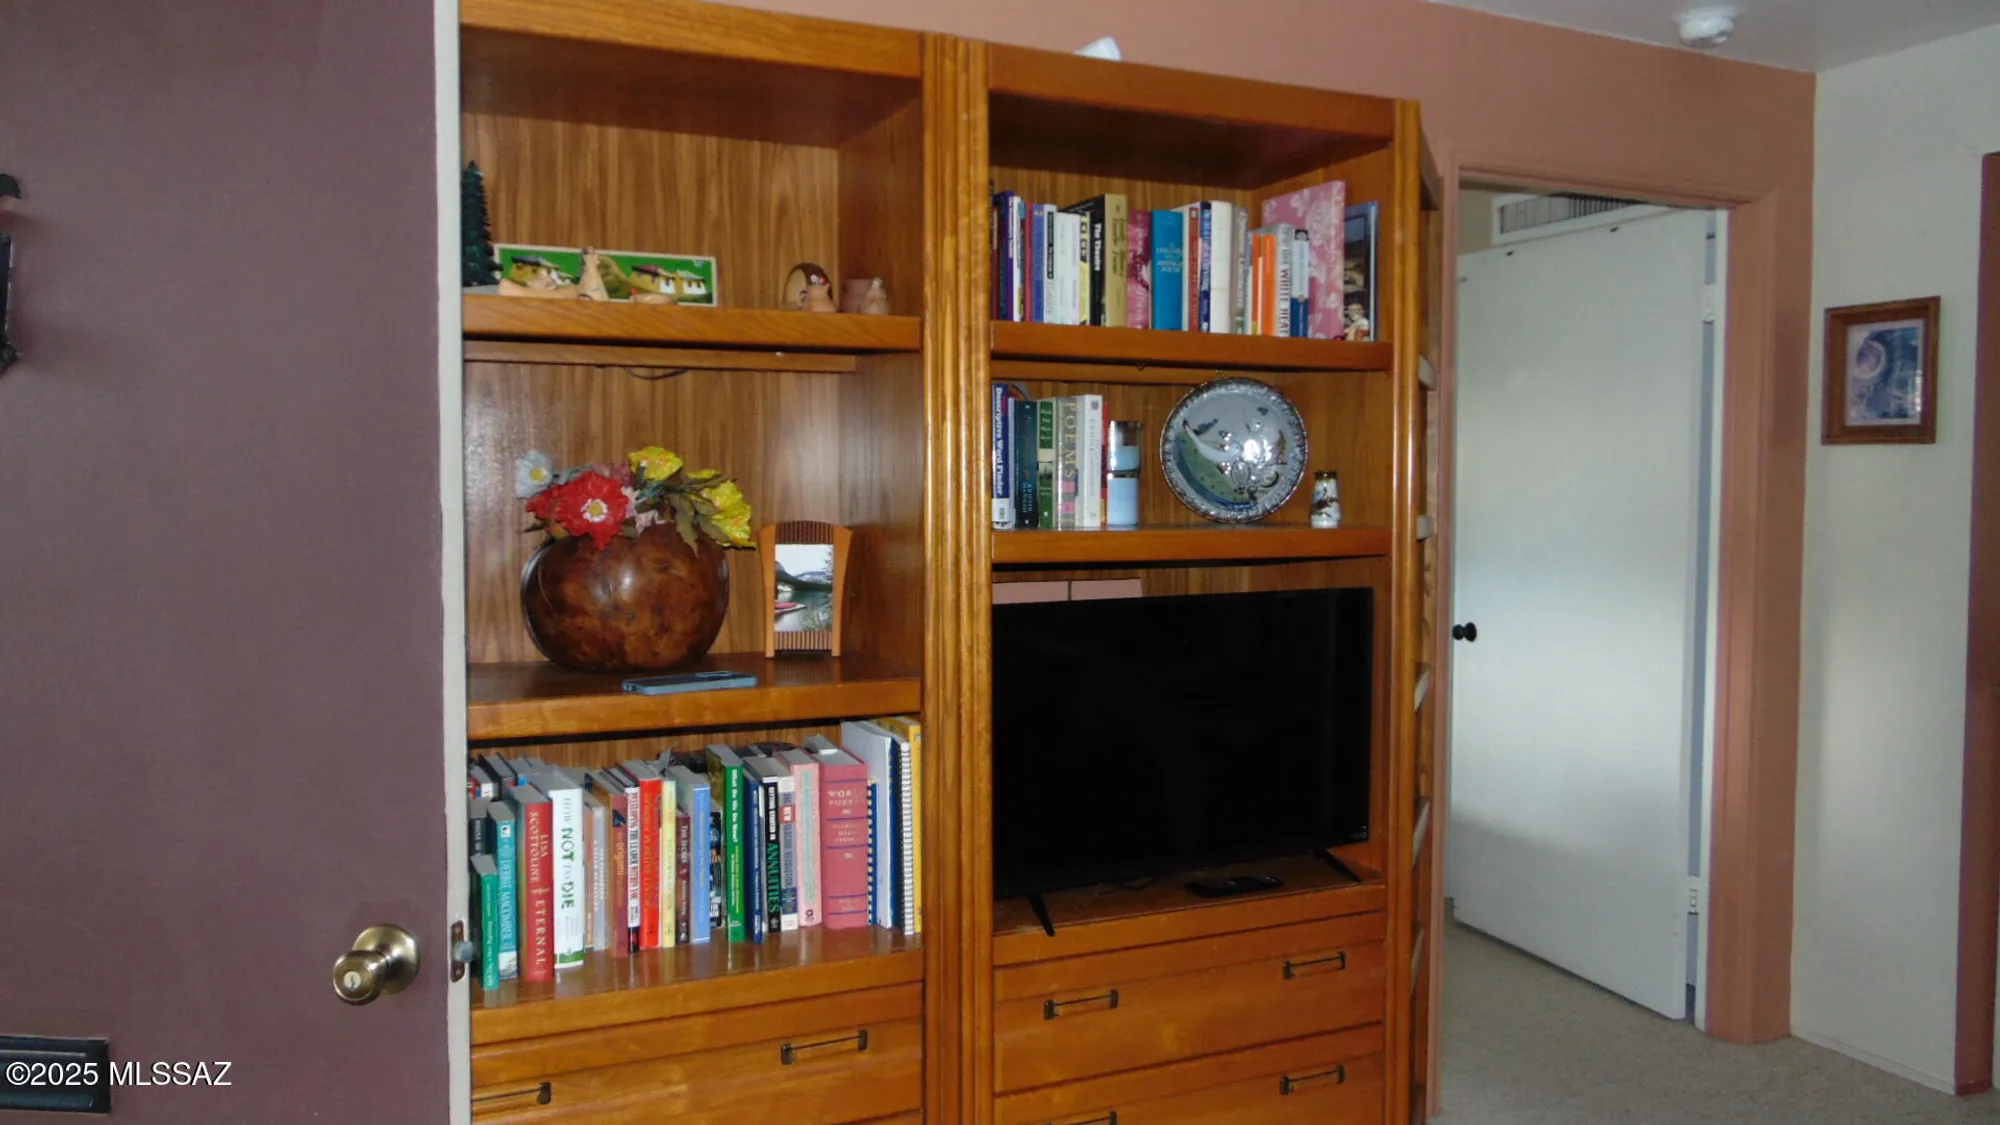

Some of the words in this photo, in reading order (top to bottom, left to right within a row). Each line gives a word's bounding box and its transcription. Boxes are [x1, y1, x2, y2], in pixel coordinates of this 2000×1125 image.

[1280, 268, 1290, 302] WHITE
[996, 387, 1004, 438] Descriptive
[1064, 402, 1078, 478] POEMS
[563, 798, 572, 822] HOW
[530, 811, 540, 882] SCOTTOLINE
[540, 834, 548, 858] LISA
[562, 828, 574, 861] NOT
[564, 864, 572, 880] TO
[768, 842, 780, 912] ANNUITIES
[562, 880, 574, 910] DIE
[536, 900, 546, 966] ETERNAL
